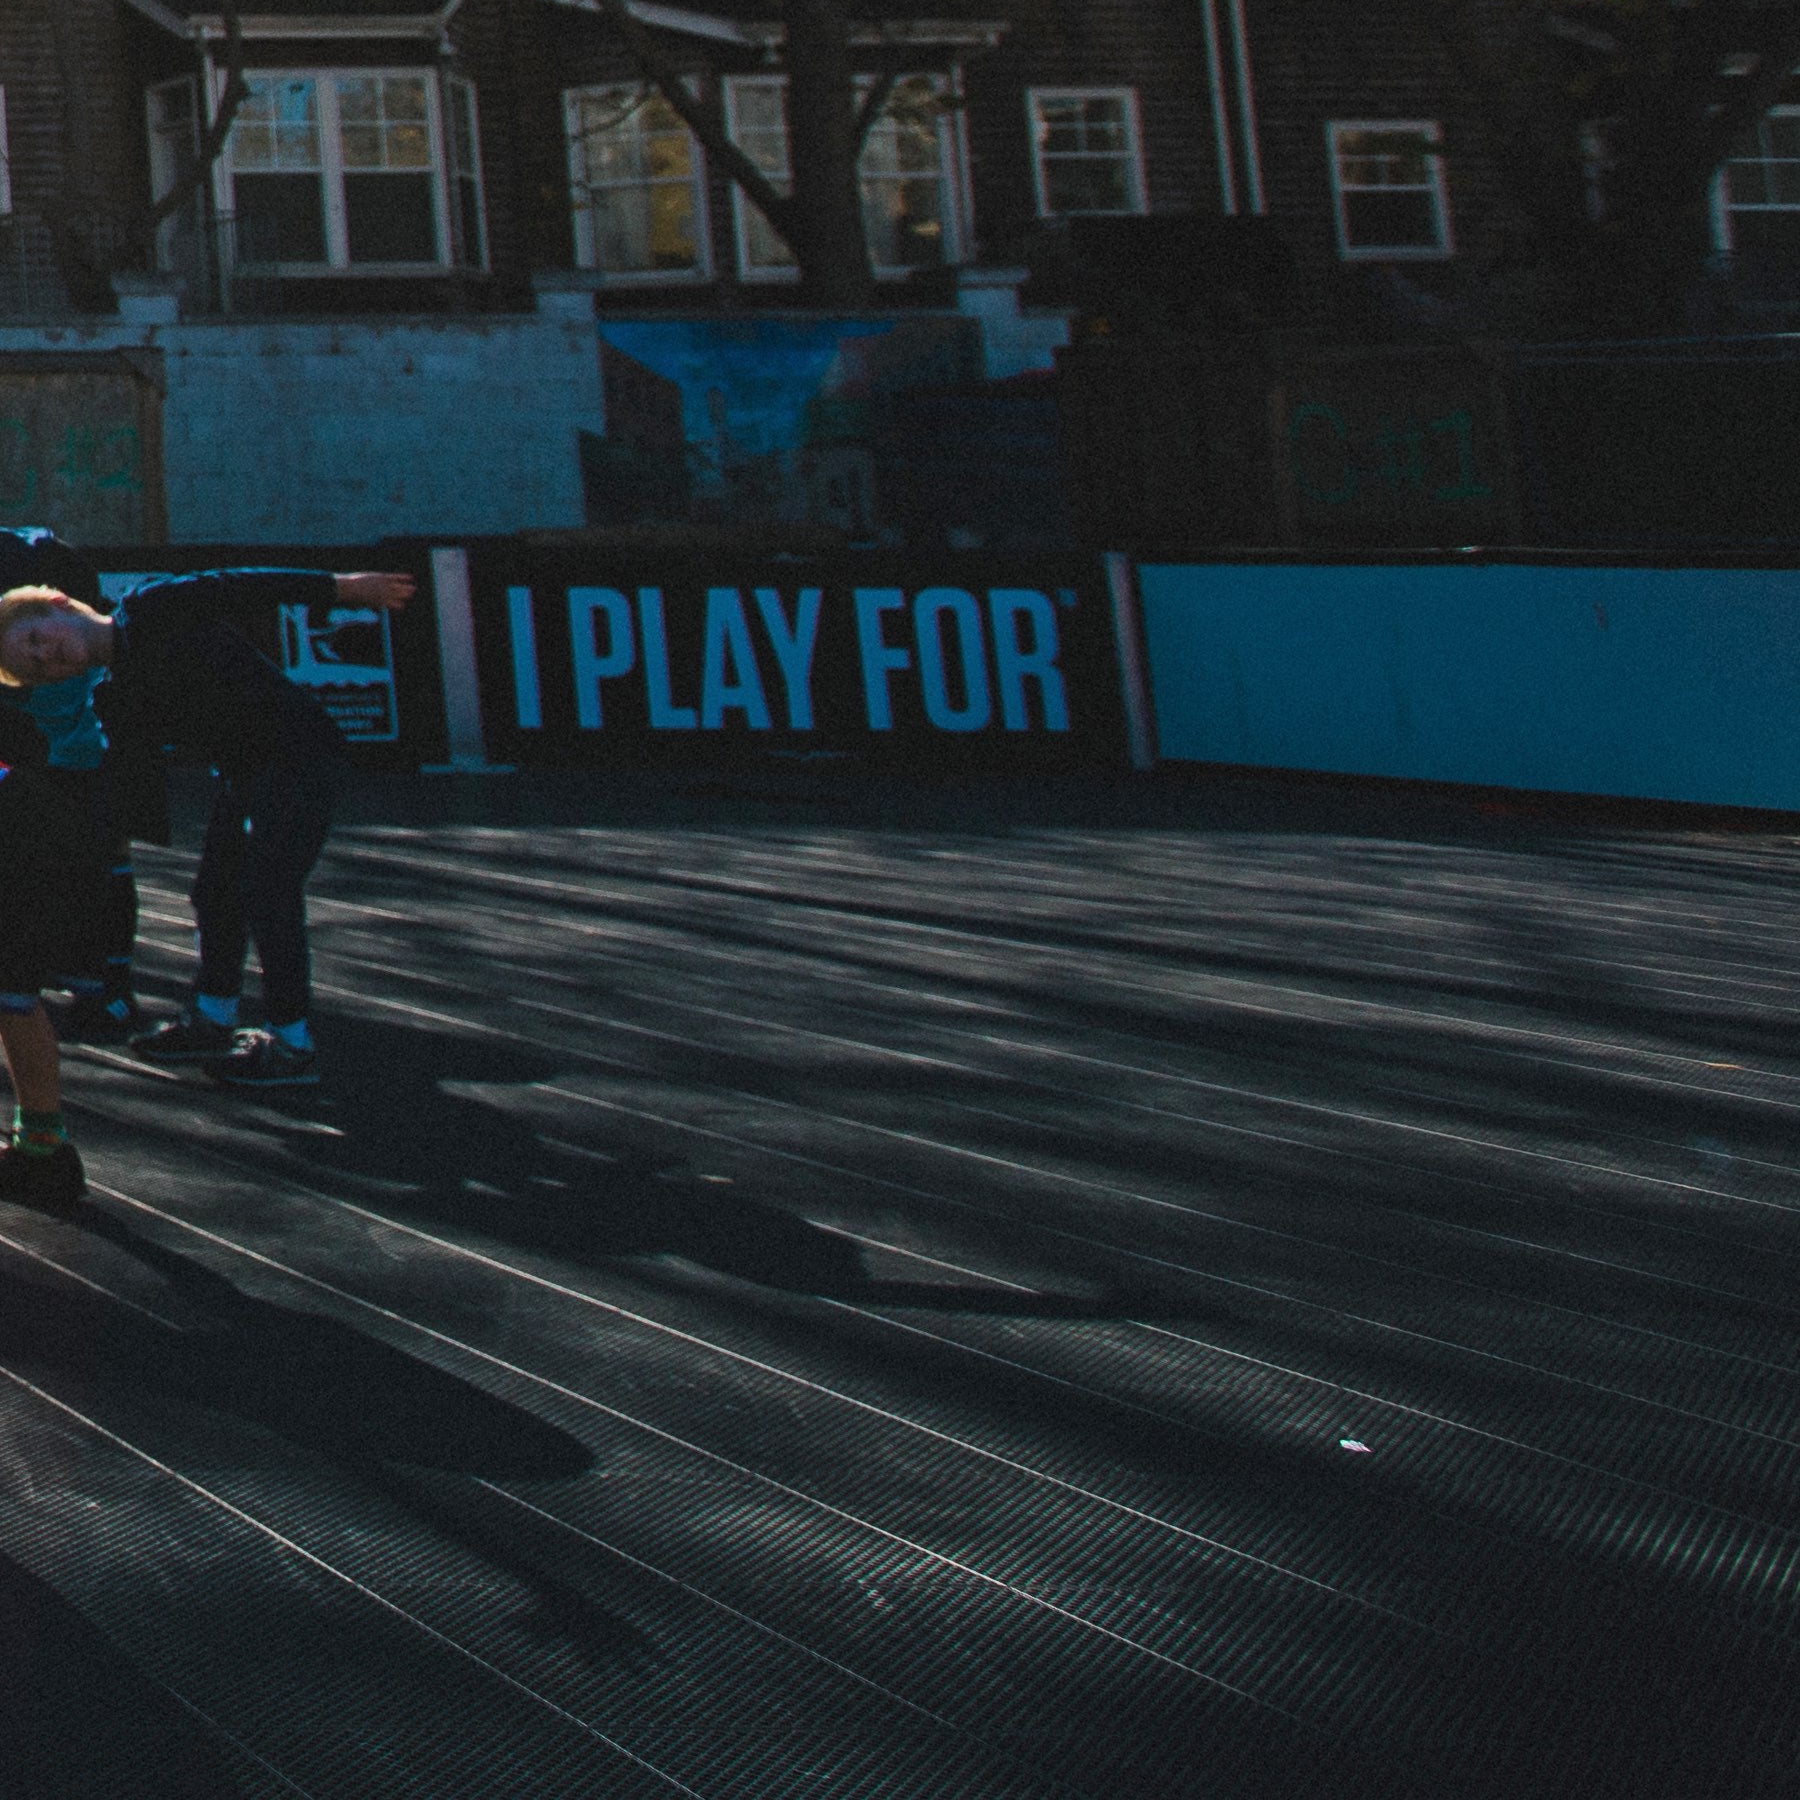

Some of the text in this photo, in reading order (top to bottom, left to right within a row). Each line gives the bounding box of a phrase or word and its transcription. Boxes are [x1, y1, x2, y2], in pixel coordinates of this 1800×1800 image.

[506, 585, 1071, 732] I PLAY FOR
